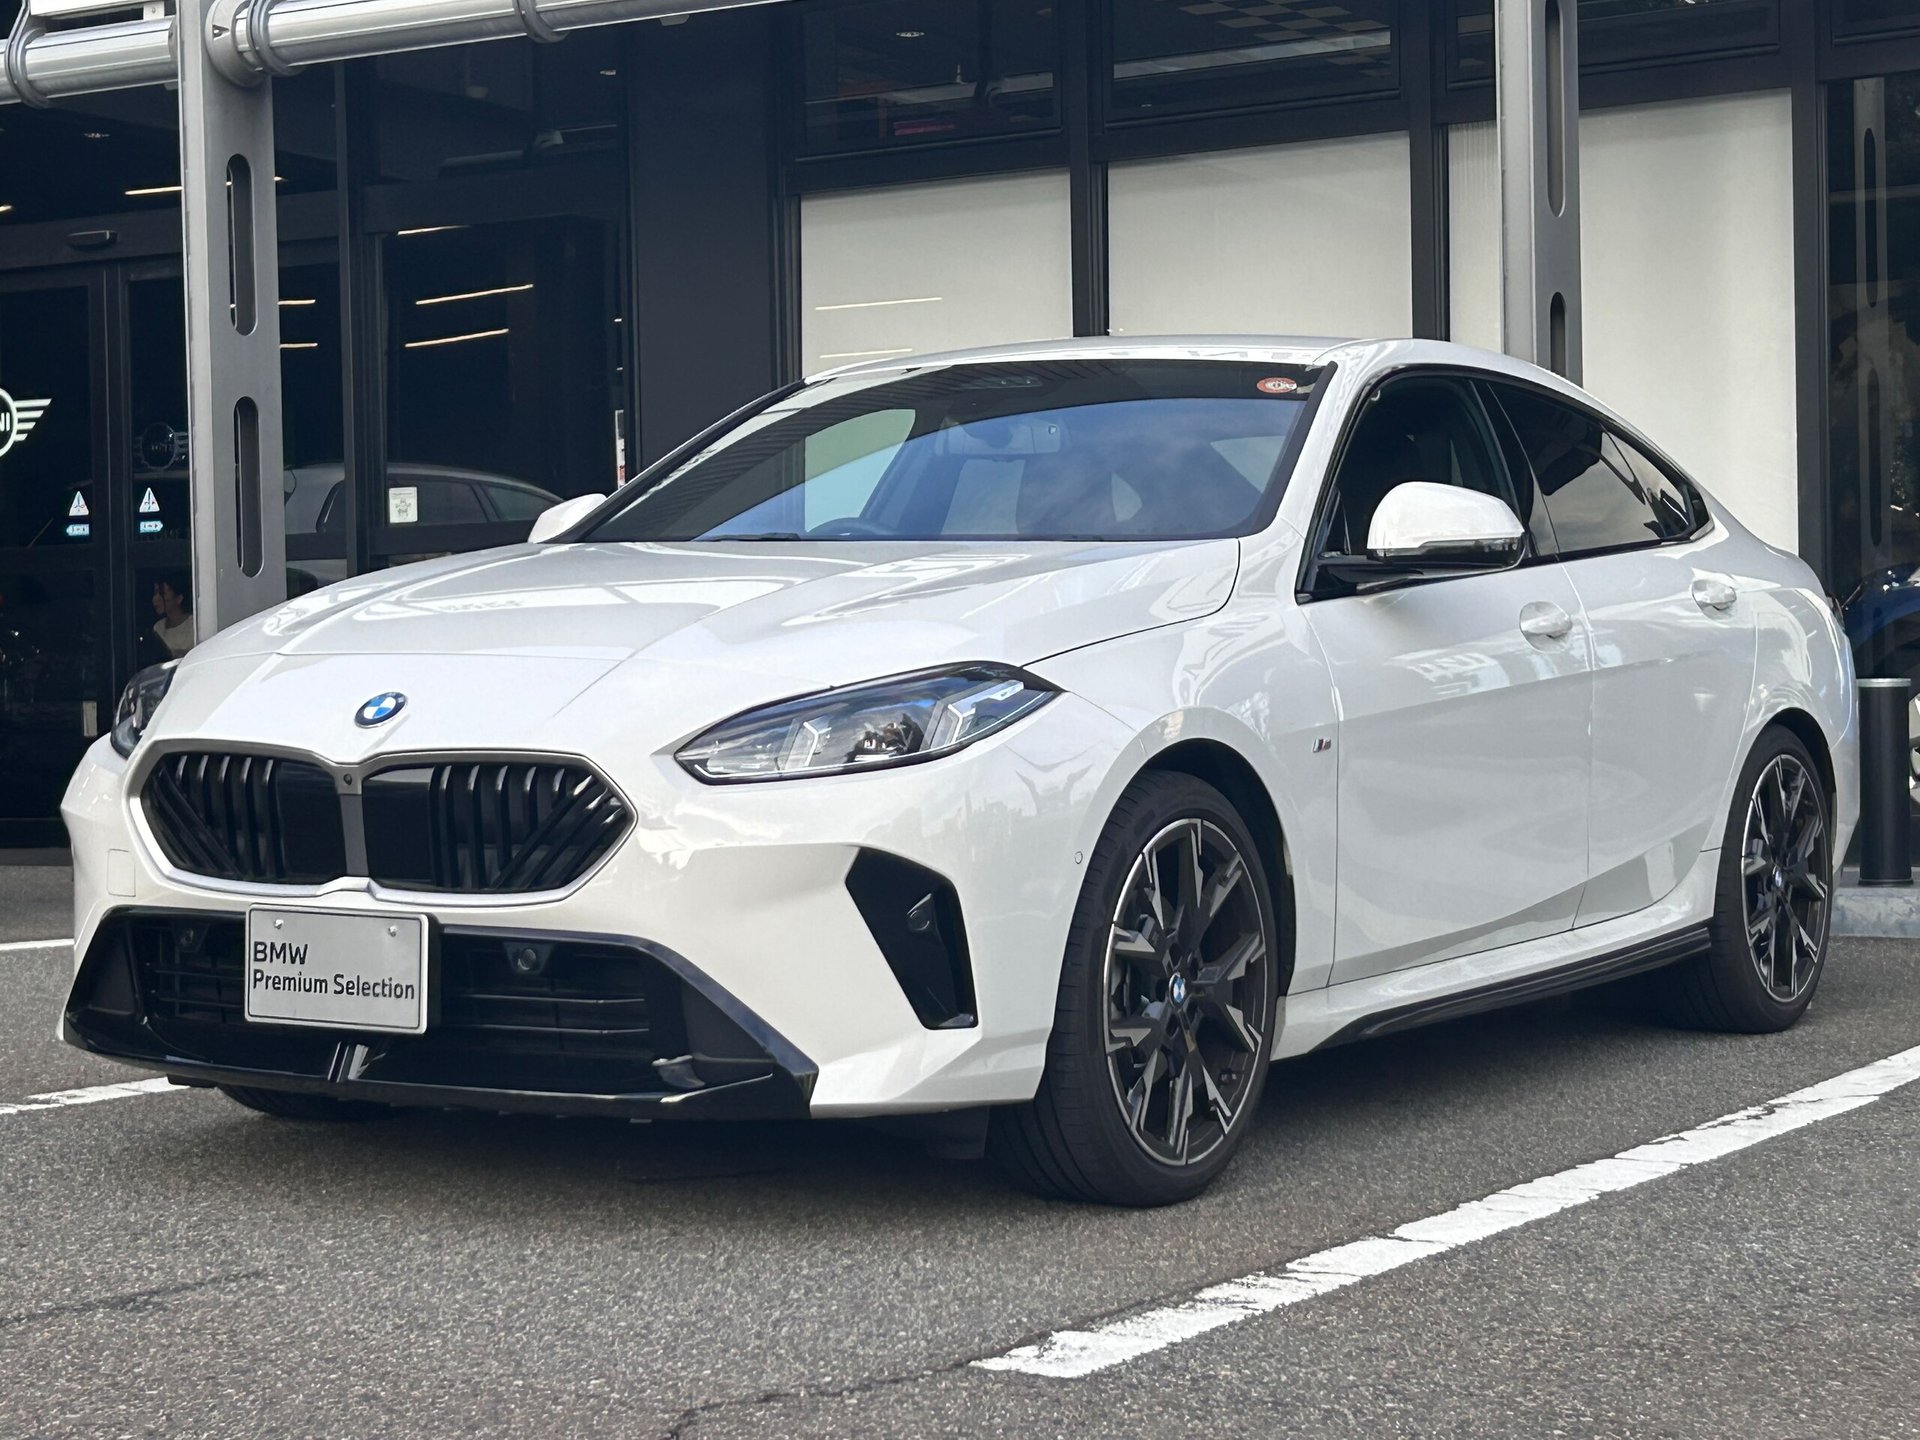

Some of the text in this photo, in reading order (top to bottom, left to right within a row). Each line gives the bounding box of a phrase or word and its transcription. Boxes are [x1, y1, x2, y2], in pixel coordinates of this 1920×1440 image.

[253, 941, 308, 965] BMW
[253, 968, 415, 1000] Premium Selection
